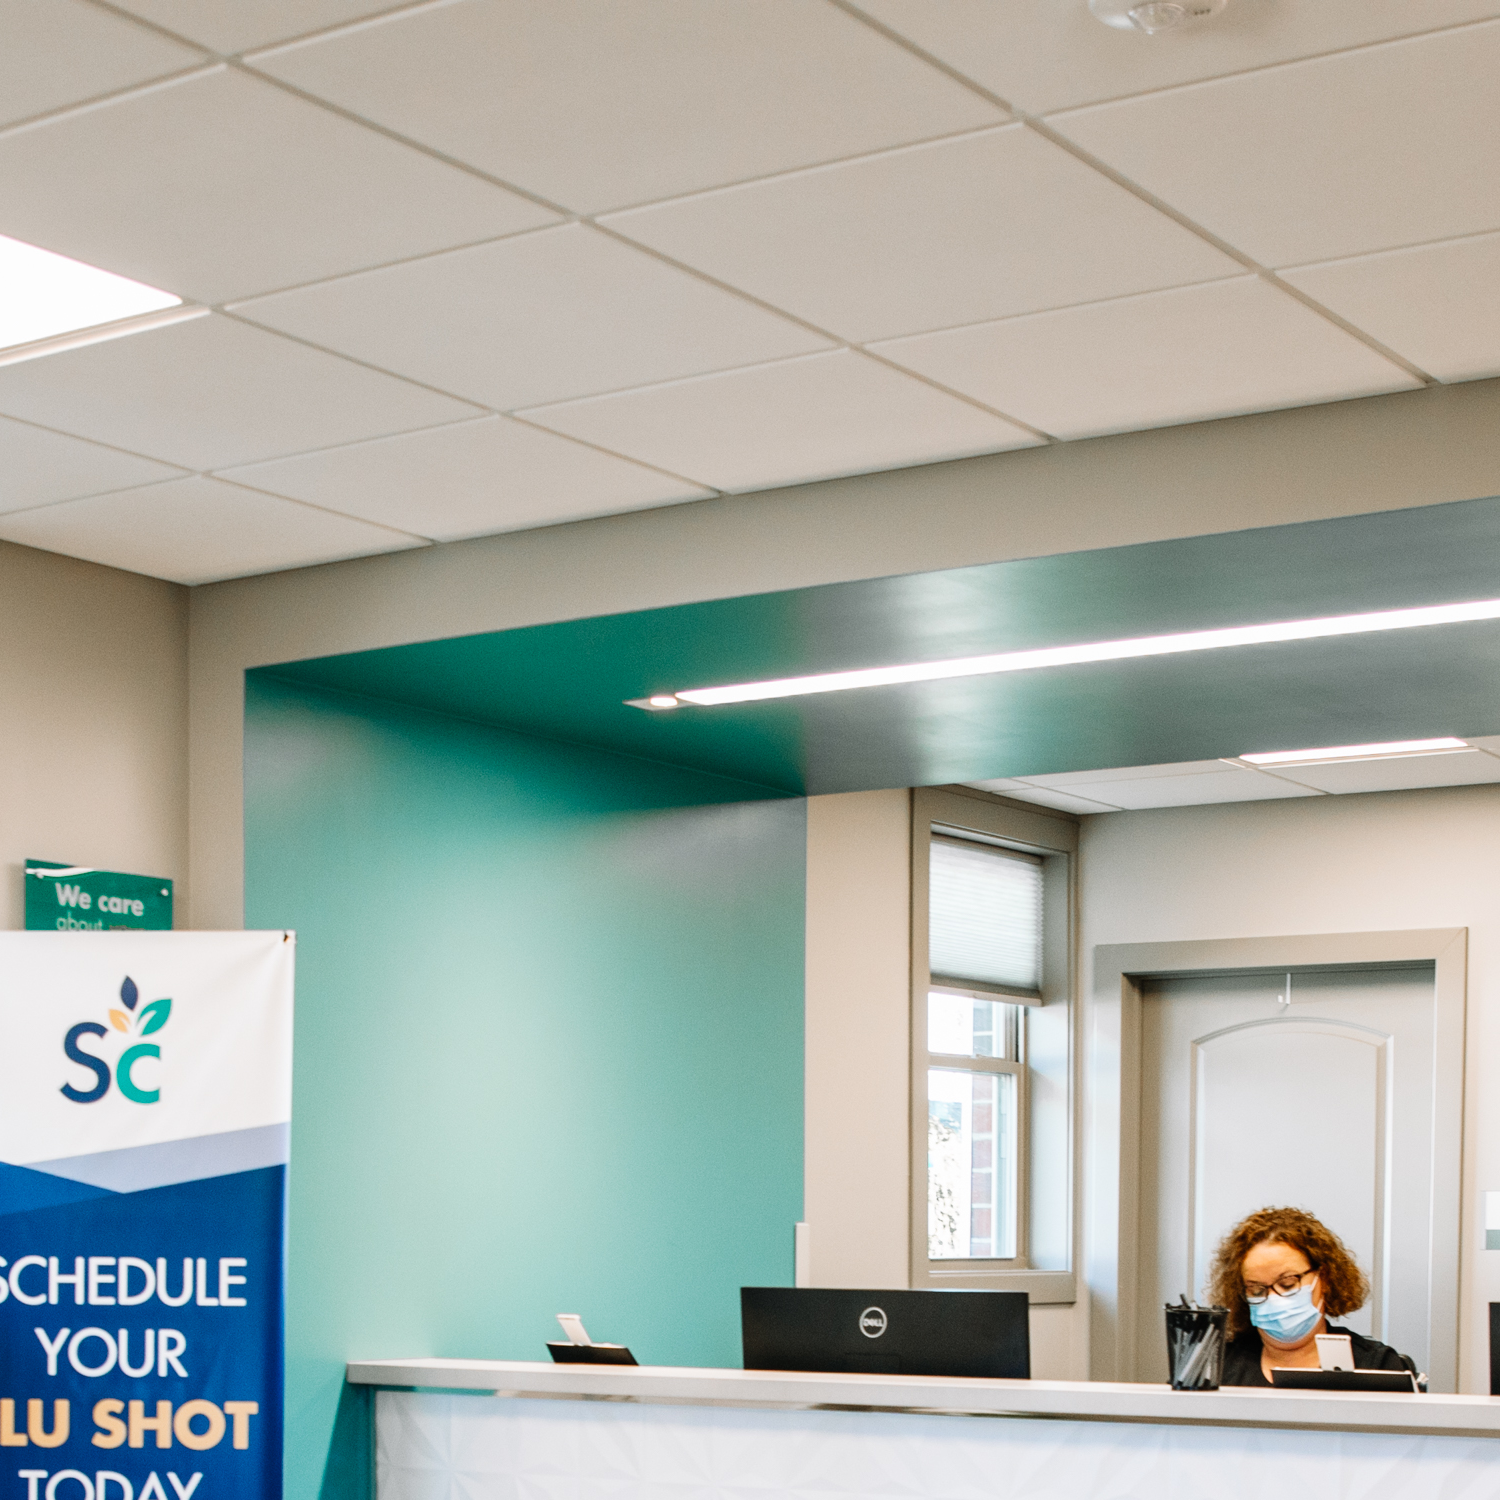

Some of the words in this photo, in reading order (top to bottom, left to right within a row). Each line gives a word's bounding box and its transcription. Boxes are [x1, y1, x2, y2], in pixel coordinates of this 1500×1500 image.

[55, 882, 92, 910] We
[98, 895, 145, 917] care
[34, 1327, 189, 1378] YOUR
[91, 1398, 259, 1451] SHOT
